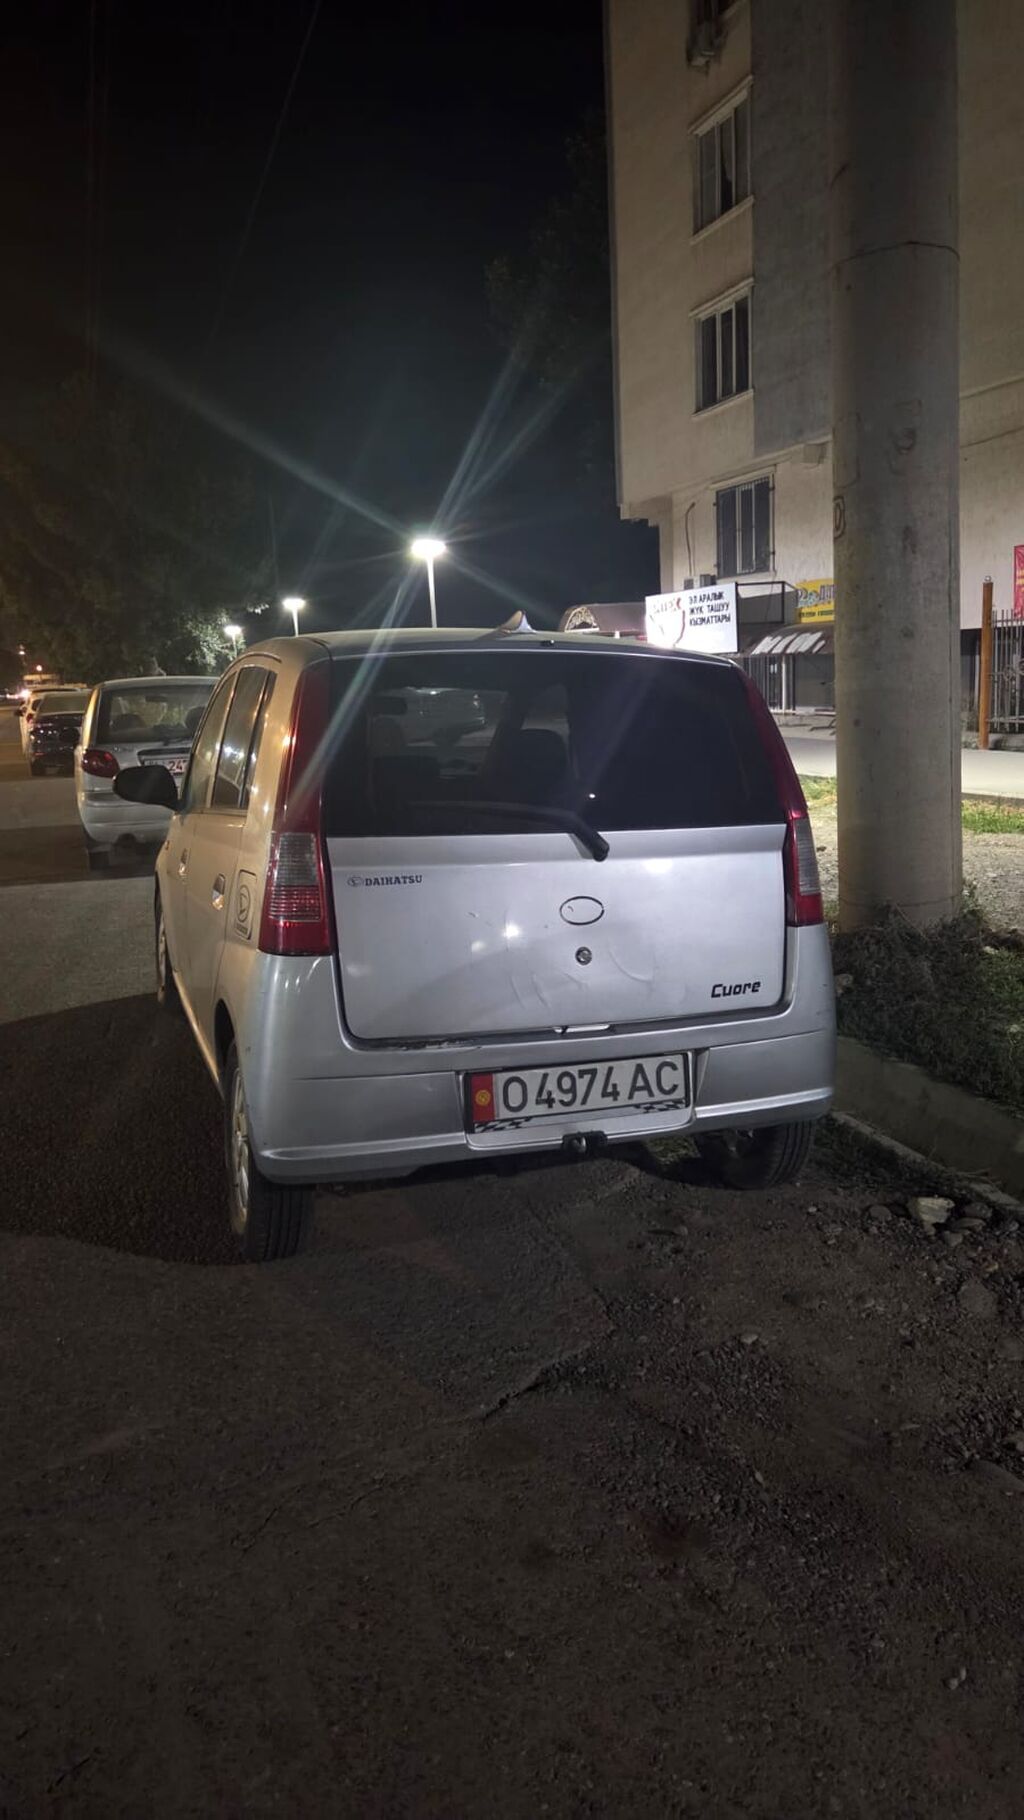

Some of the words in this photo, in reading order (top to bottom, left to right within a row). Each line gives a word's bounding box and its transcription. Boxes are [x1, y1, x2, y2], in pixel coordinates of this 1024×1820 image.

[699, 591, 723, 603] АРАЛЫК
[707, 602, 729, 613] ТАШУУ
[689, 613, 731, 626] КЫЗМАТТАРЫ
[364, 875, 422, 886] DAIHATSU
[711, 981, 761, 998] Cuore
